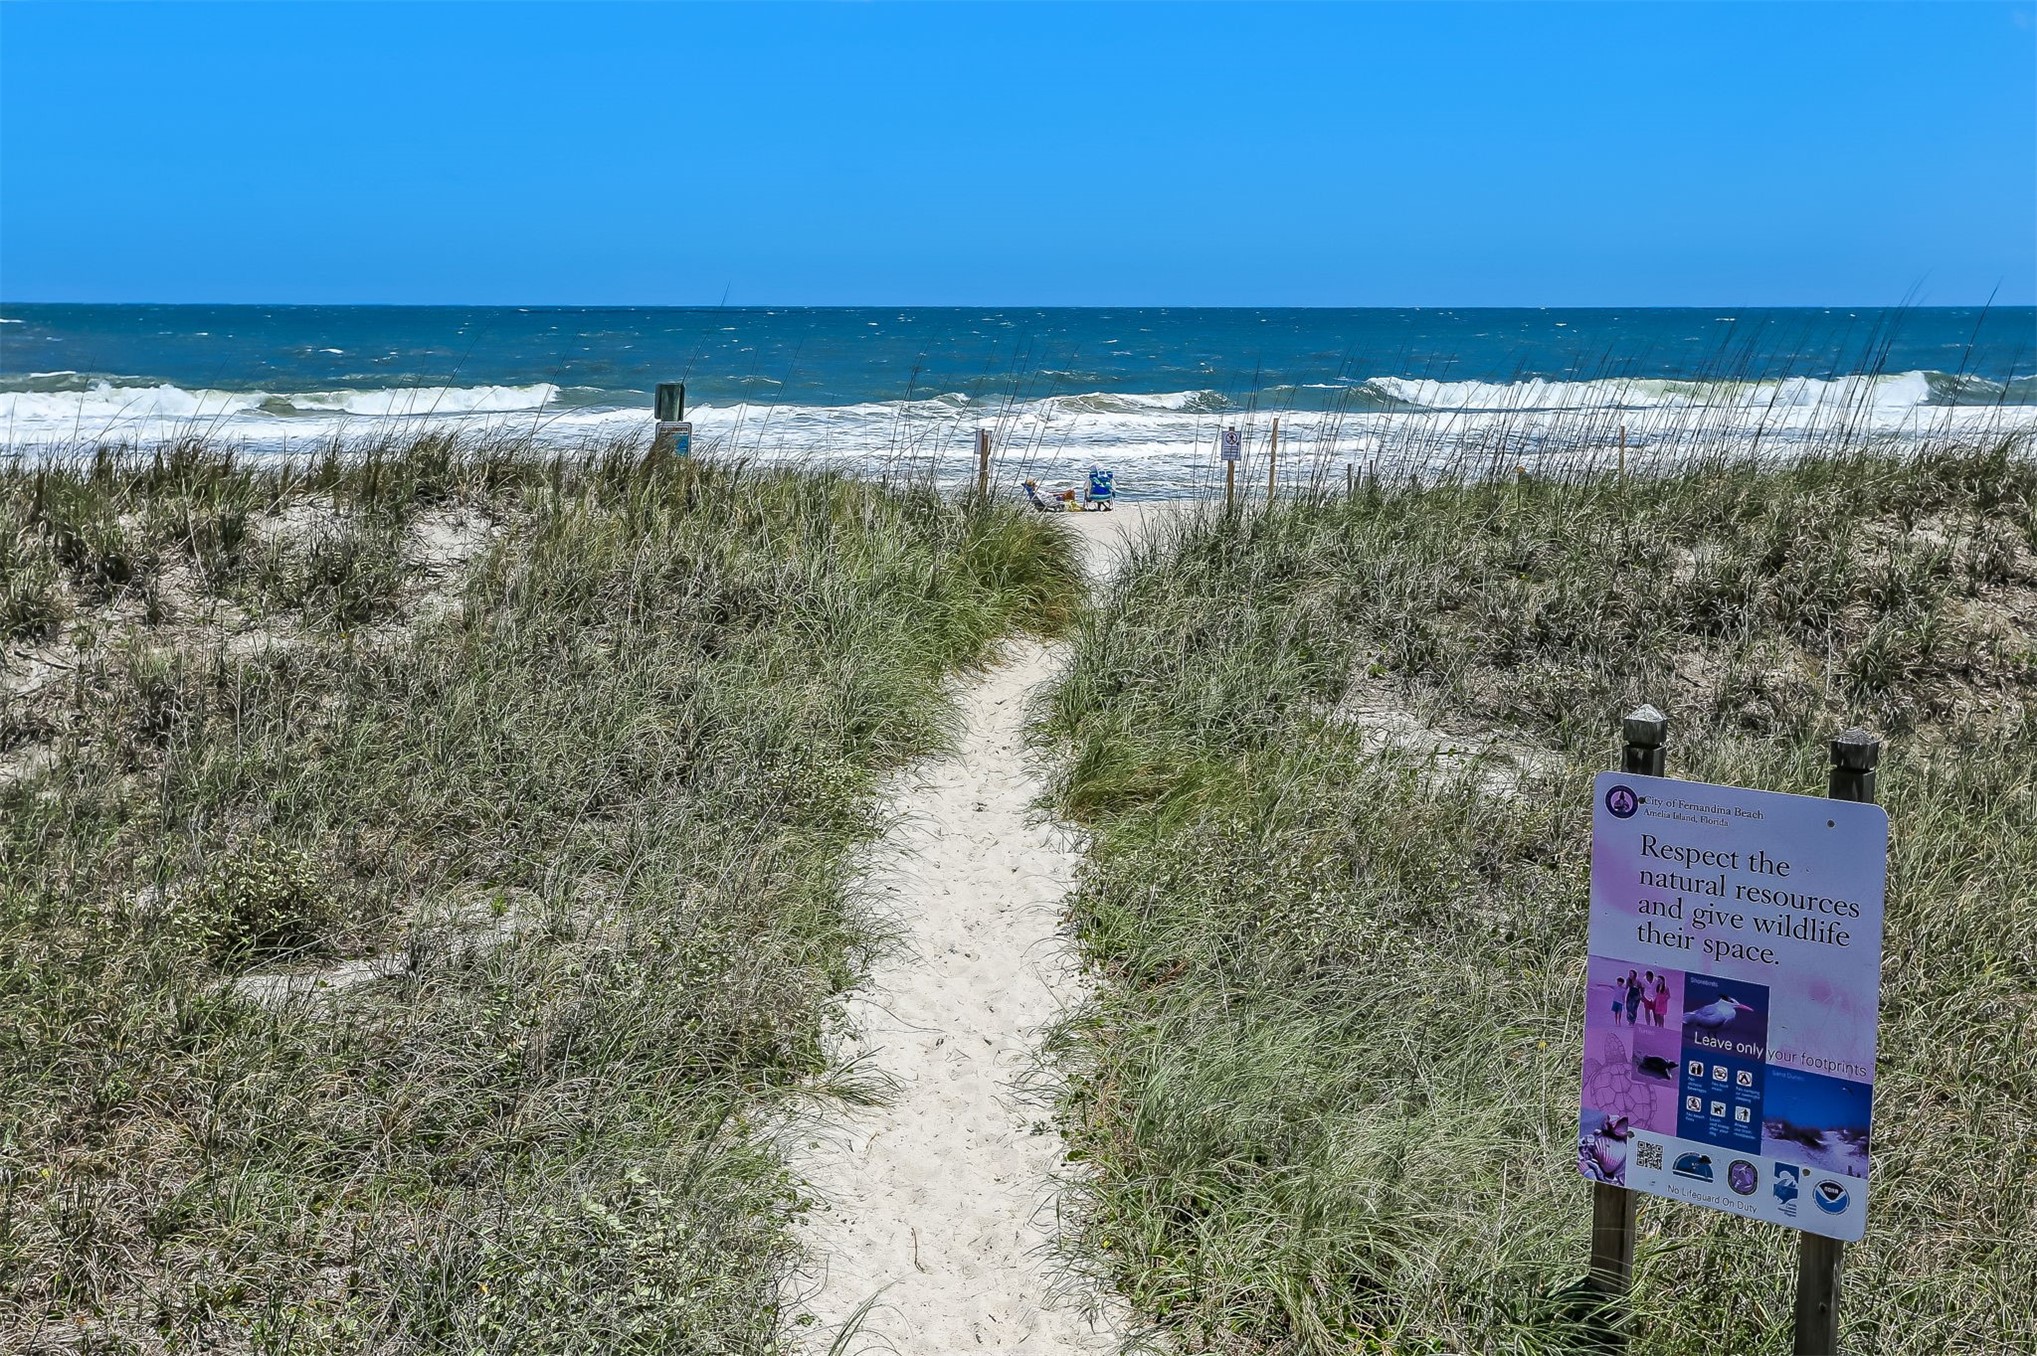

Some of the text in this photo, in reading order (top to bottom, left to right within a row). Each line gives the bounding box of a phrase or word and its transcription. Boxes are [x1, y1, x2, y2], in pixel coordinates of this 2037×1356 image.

[1642, 795, 1764, 820] City of Fernandina Beach
[1643, 808, 1729, 827] Amelia Island, Florida
[1640, 834, 1790, 877] Respect the
[1639, 868, 1860, 918] natural resources
[1637, 921, 1779, 965] their space.
[1638, 897, 1850, 947] and give wildlife
[1694, 1031, 1867, 1079] Leave only your footprints
[1667, 1184, 1758, 1214] No Lifeguard On Duty
